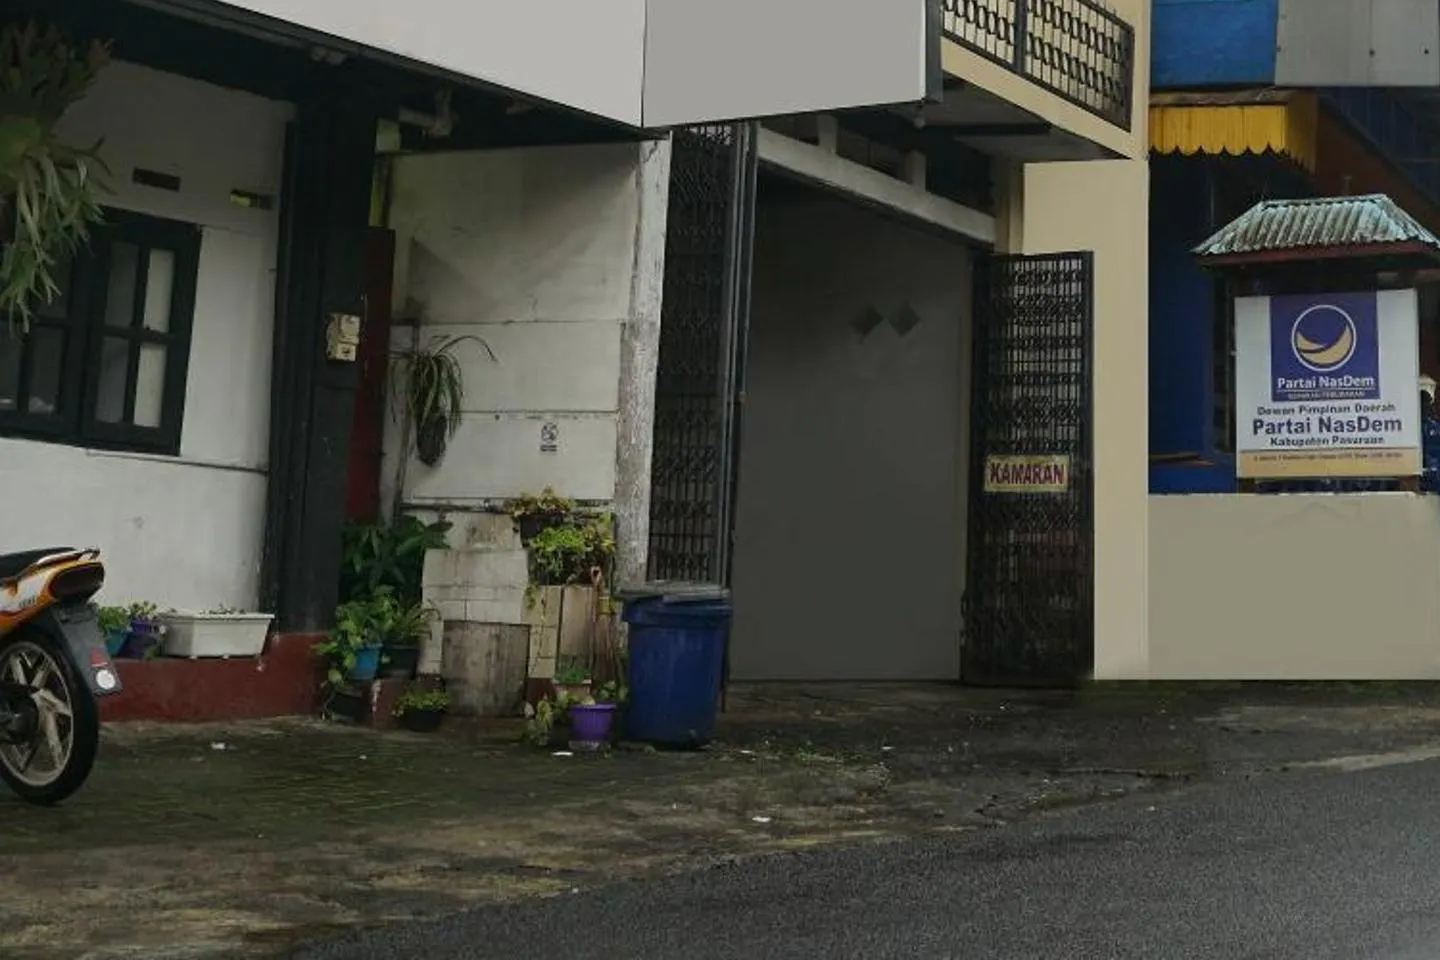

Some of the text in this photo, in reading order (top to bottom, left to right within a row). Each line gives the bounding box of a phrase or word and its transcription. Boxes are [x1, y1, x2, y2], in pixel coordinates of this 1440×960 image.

[1277, 374, 1375, 389] Partai NasDem
[1257, 402, 1396, 416] Dewan Pimpinan Daerah
[1252, 415, 1403, 436] Partai NasDem
